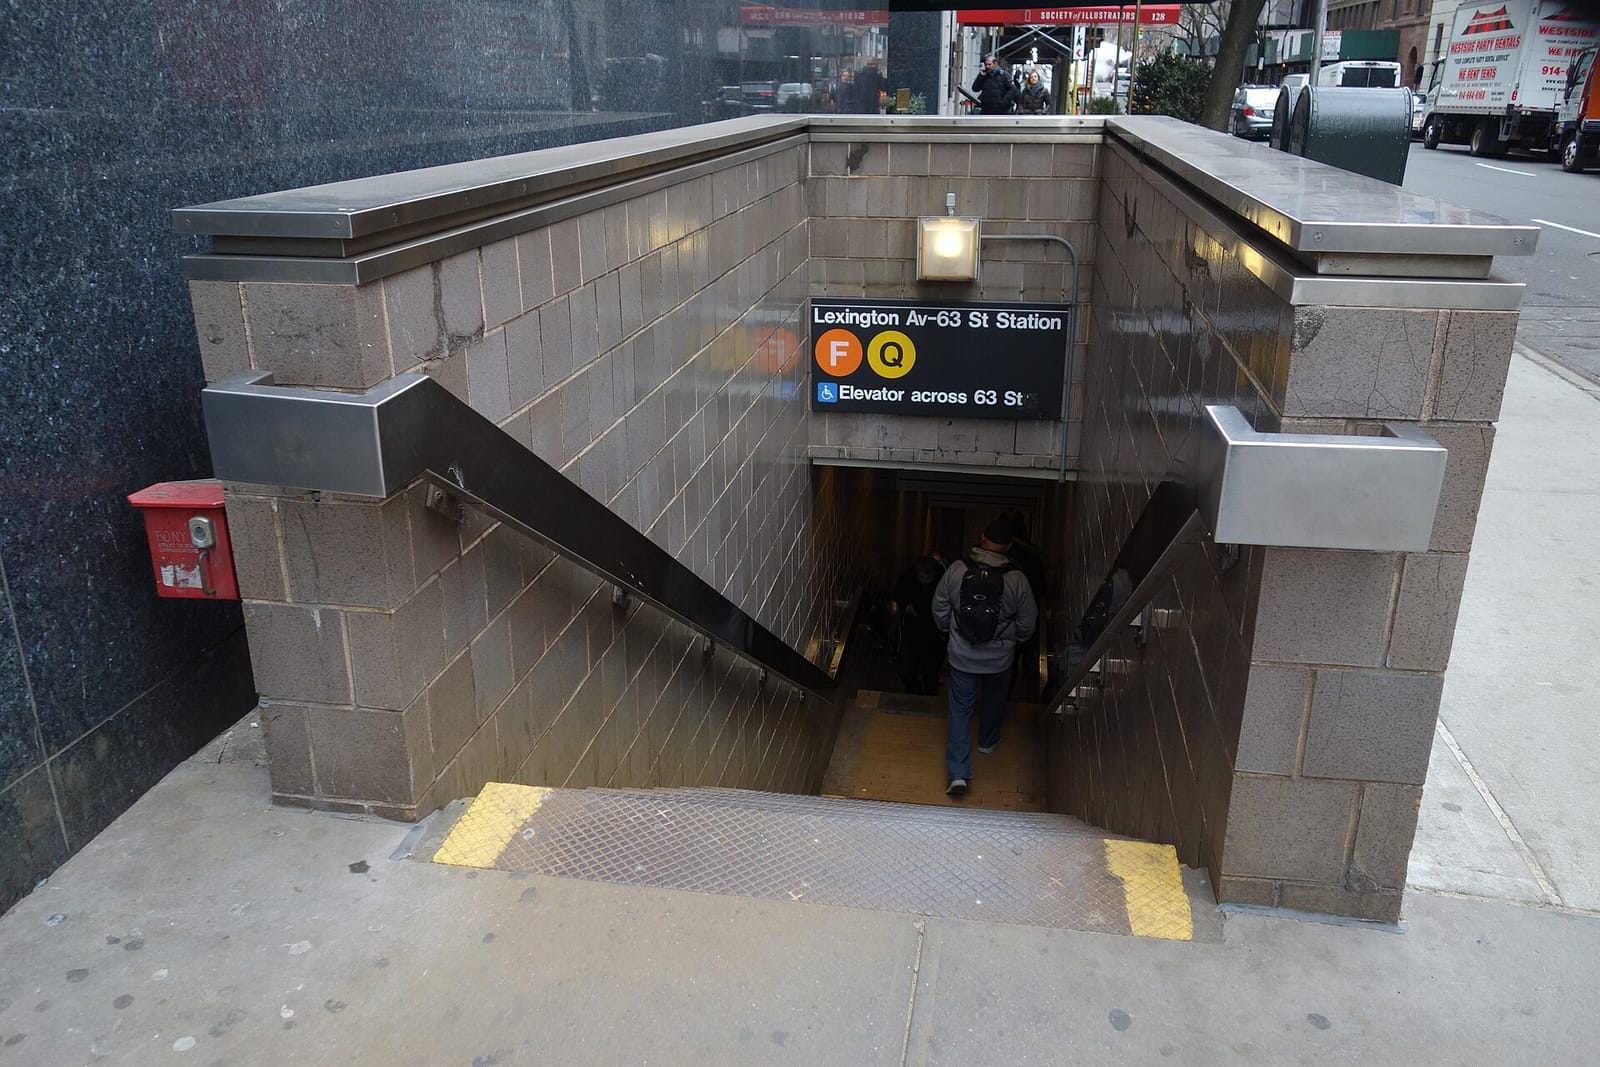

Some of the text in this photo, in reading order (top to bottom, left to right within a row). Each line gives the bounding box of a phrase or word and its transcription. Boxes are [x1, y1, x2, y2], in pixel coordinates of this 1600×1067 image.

[1040, 11, 1073, 20] SOCIETY
[1151, 12, 1166, 21] 128
[1451, 34, 1521, 54] WESTSIDE PARTY RENTALS
[814, 308, 1062, 330] Lexington Av-63 St Station
[829, 340, 904, 369] F Q
[839, 385, 1024, 407] Elevator across 63 St
